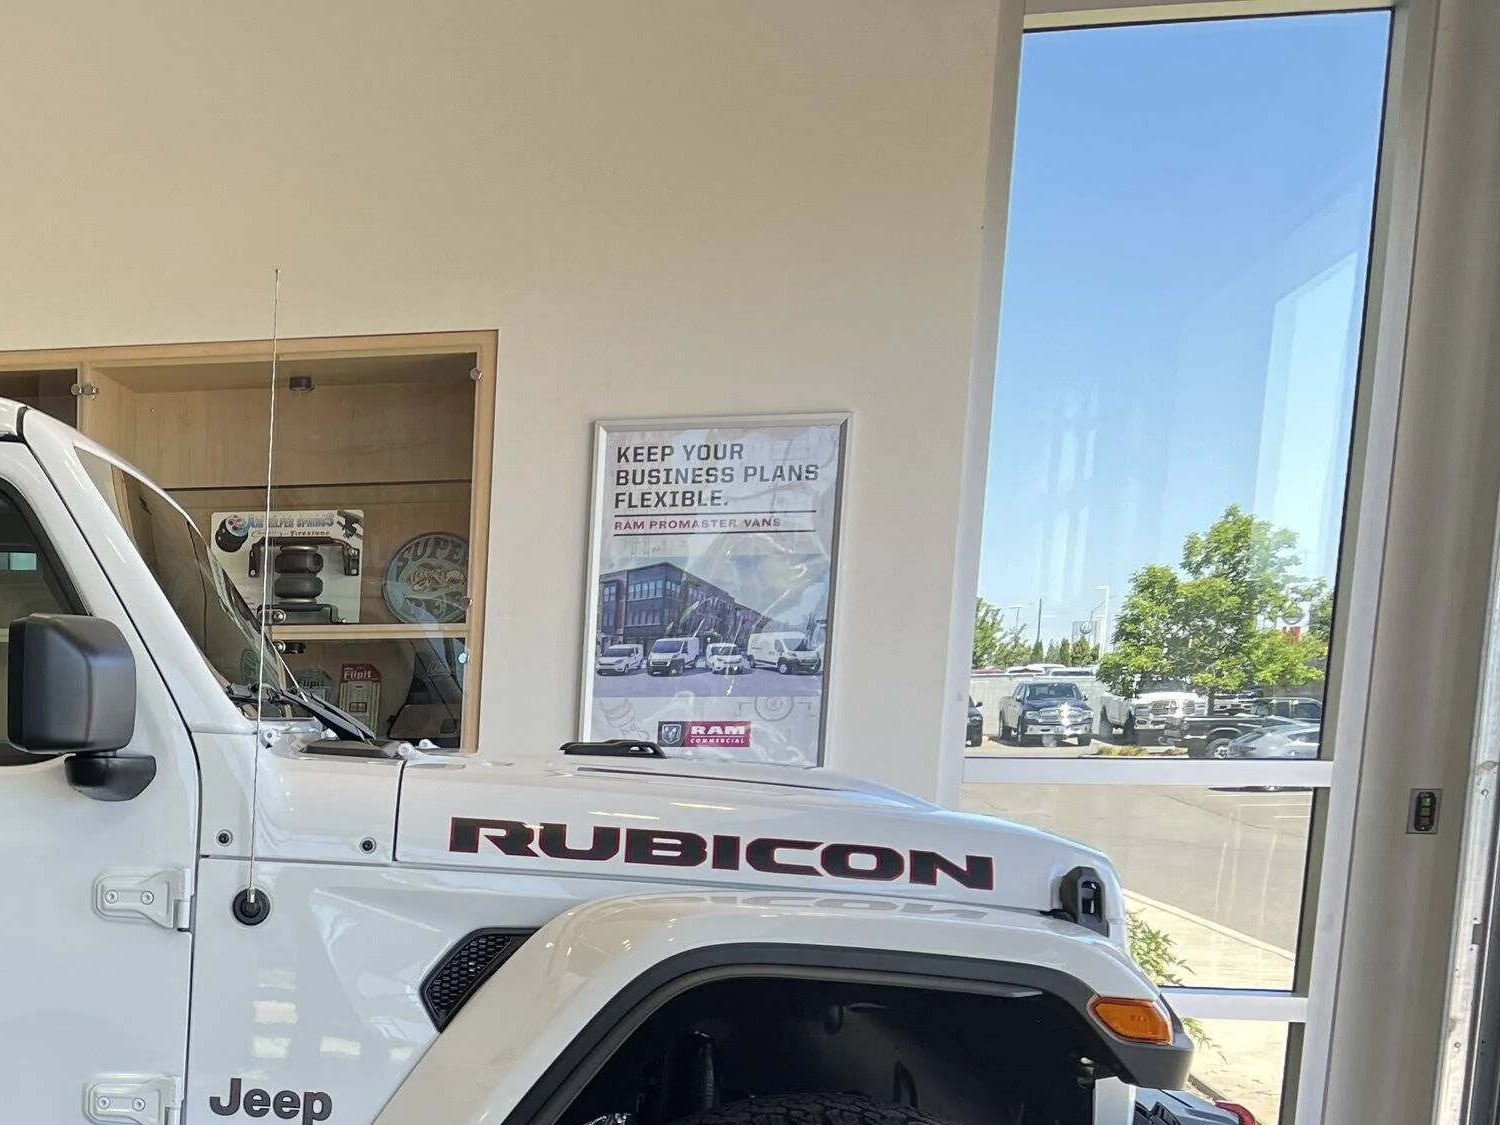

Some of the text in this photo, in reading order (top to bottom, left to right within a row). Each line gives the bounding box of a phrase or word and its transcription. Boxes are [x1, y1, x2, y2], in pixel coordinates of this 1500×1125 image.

[616, 443, 744, 463] KEEP YOUR
[615, 464, 820, 486] BUSINESS PLANS
[614, 489, 729, 509] FLEXIBLE.
[614, 518, 781, 531] RAM PROMASTER VANS
[691, 725, 745, 735] RAM
[449, 816, 995, 891] RUBICON
